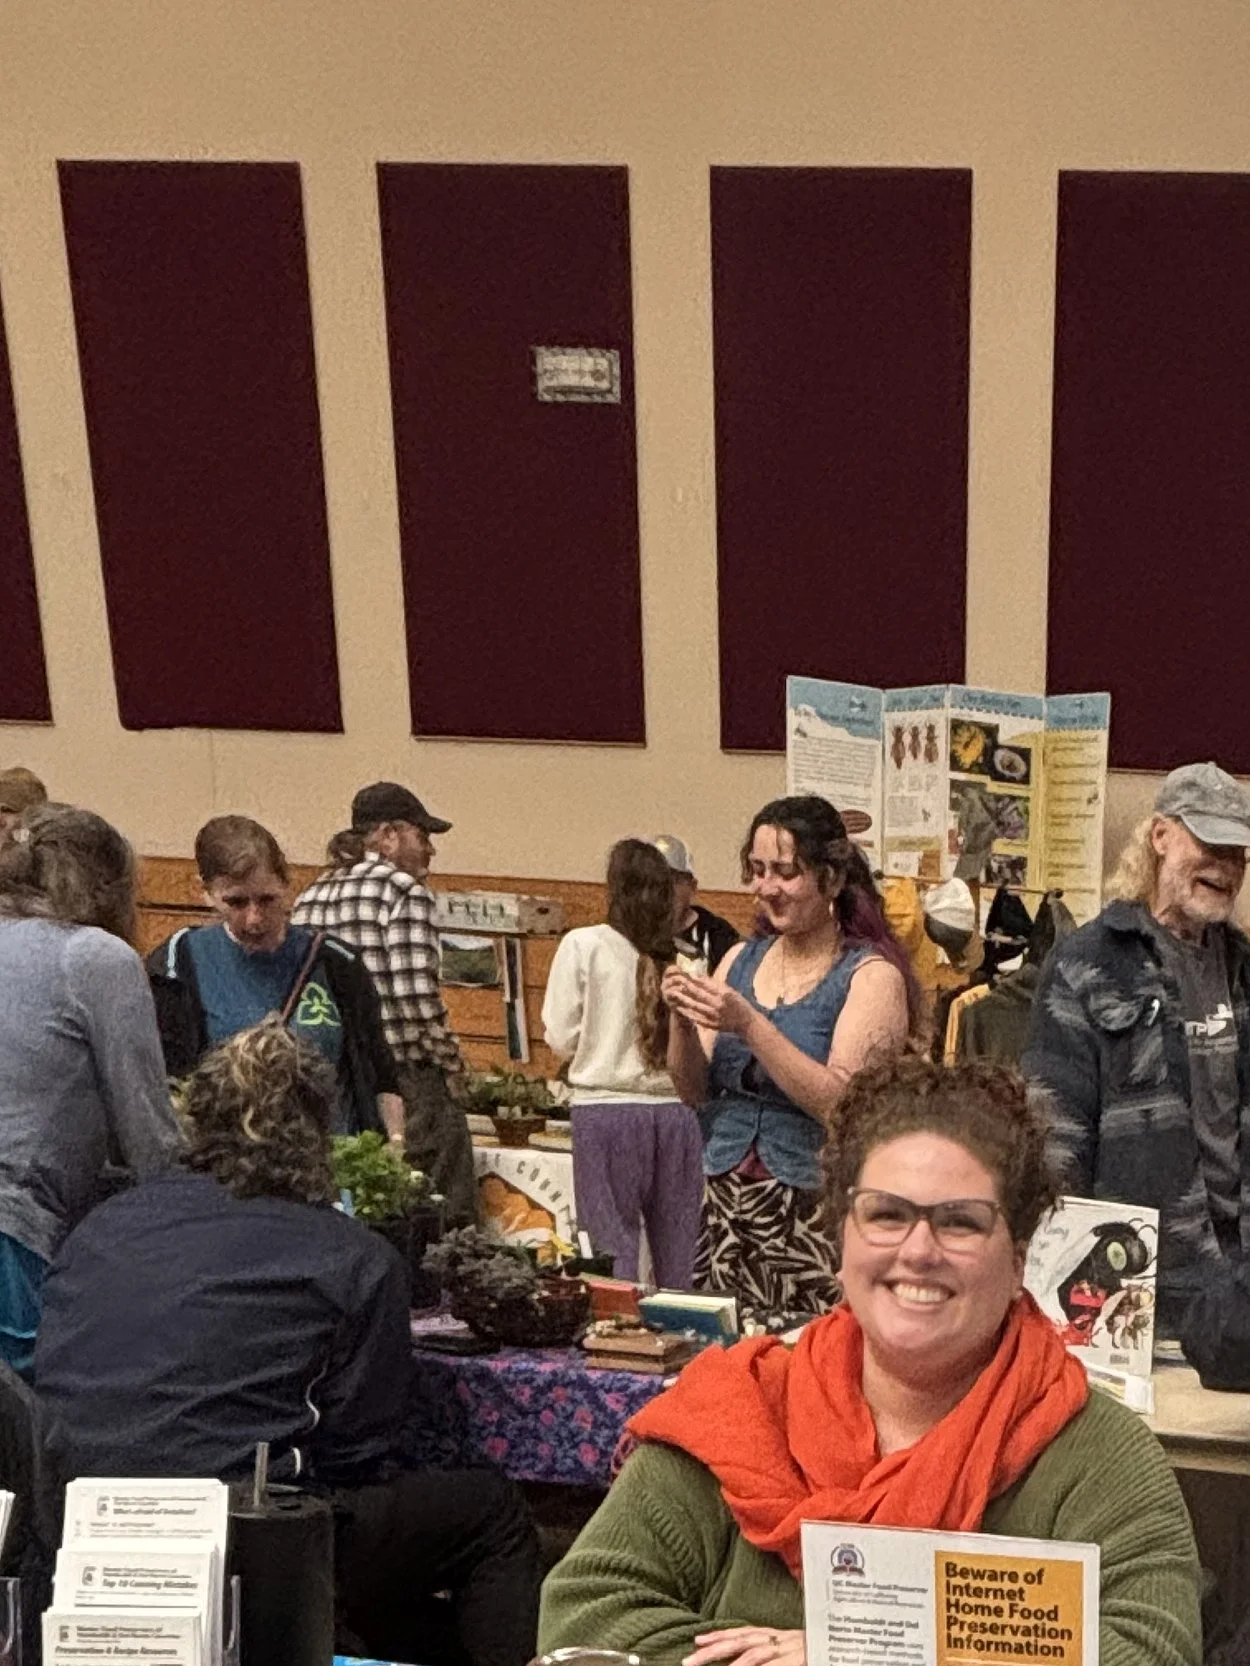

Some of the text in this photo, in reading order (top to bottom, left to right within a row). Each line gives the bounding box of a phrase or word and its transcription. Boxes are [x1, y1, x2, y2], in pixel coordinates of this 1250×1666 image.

[945, 1561, 1044, 1585] Beware of
[946, 1579, 1025, 1602] Internet
[946, 1597, 1004, 1618] Home
[1008, 1602, 1059, 1622] Food
[946, 1615, 1073, 1640] Preservation
[947, 1632, 1065, 1658] Information
